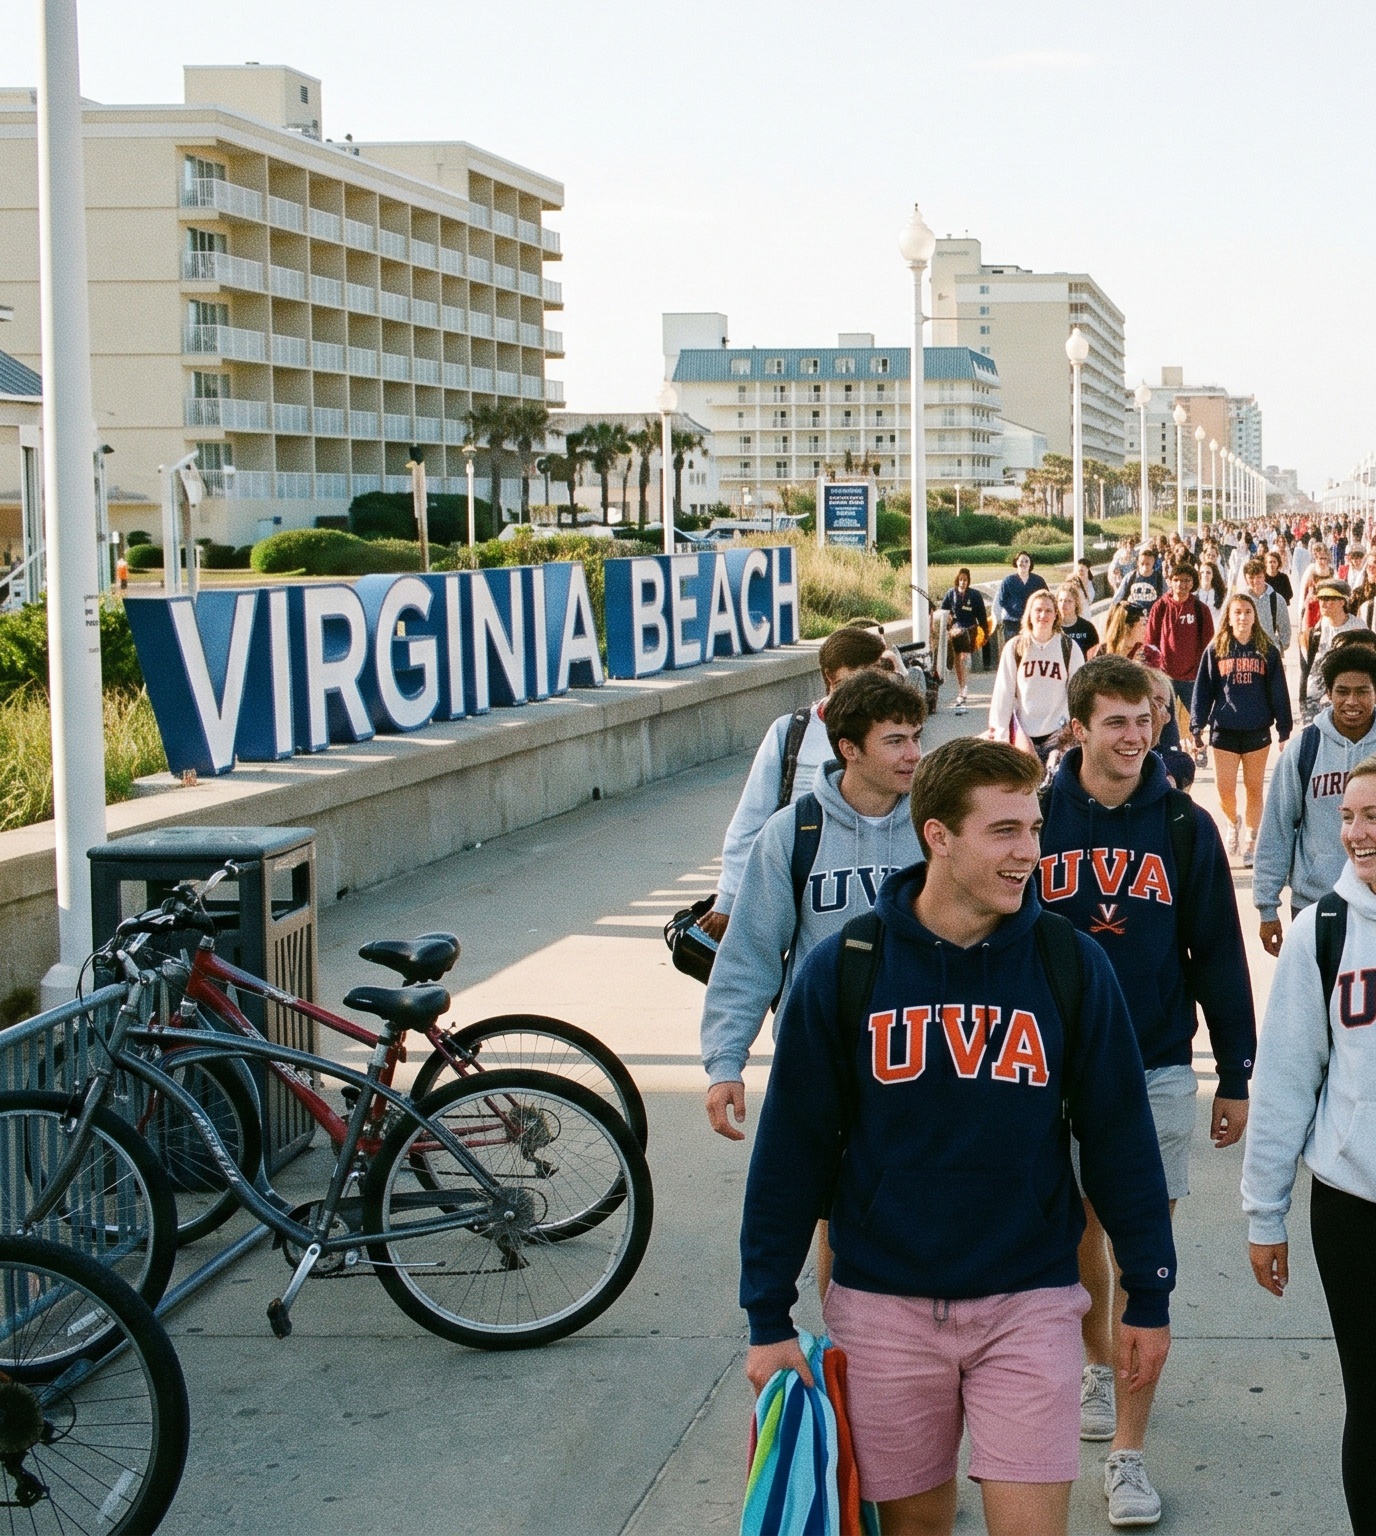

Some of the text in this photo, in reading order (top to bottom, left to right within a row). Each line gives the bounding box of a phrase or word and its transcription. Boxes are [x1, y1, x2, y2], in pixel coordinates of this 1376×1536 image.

[166, 546, 800, 775] VIRGINIA BEACH
[1022, 660, 1062, 681] UVA
[1038, 847, 1173, 906] UVA
[867, 1003, 1051, 1088] UVA
